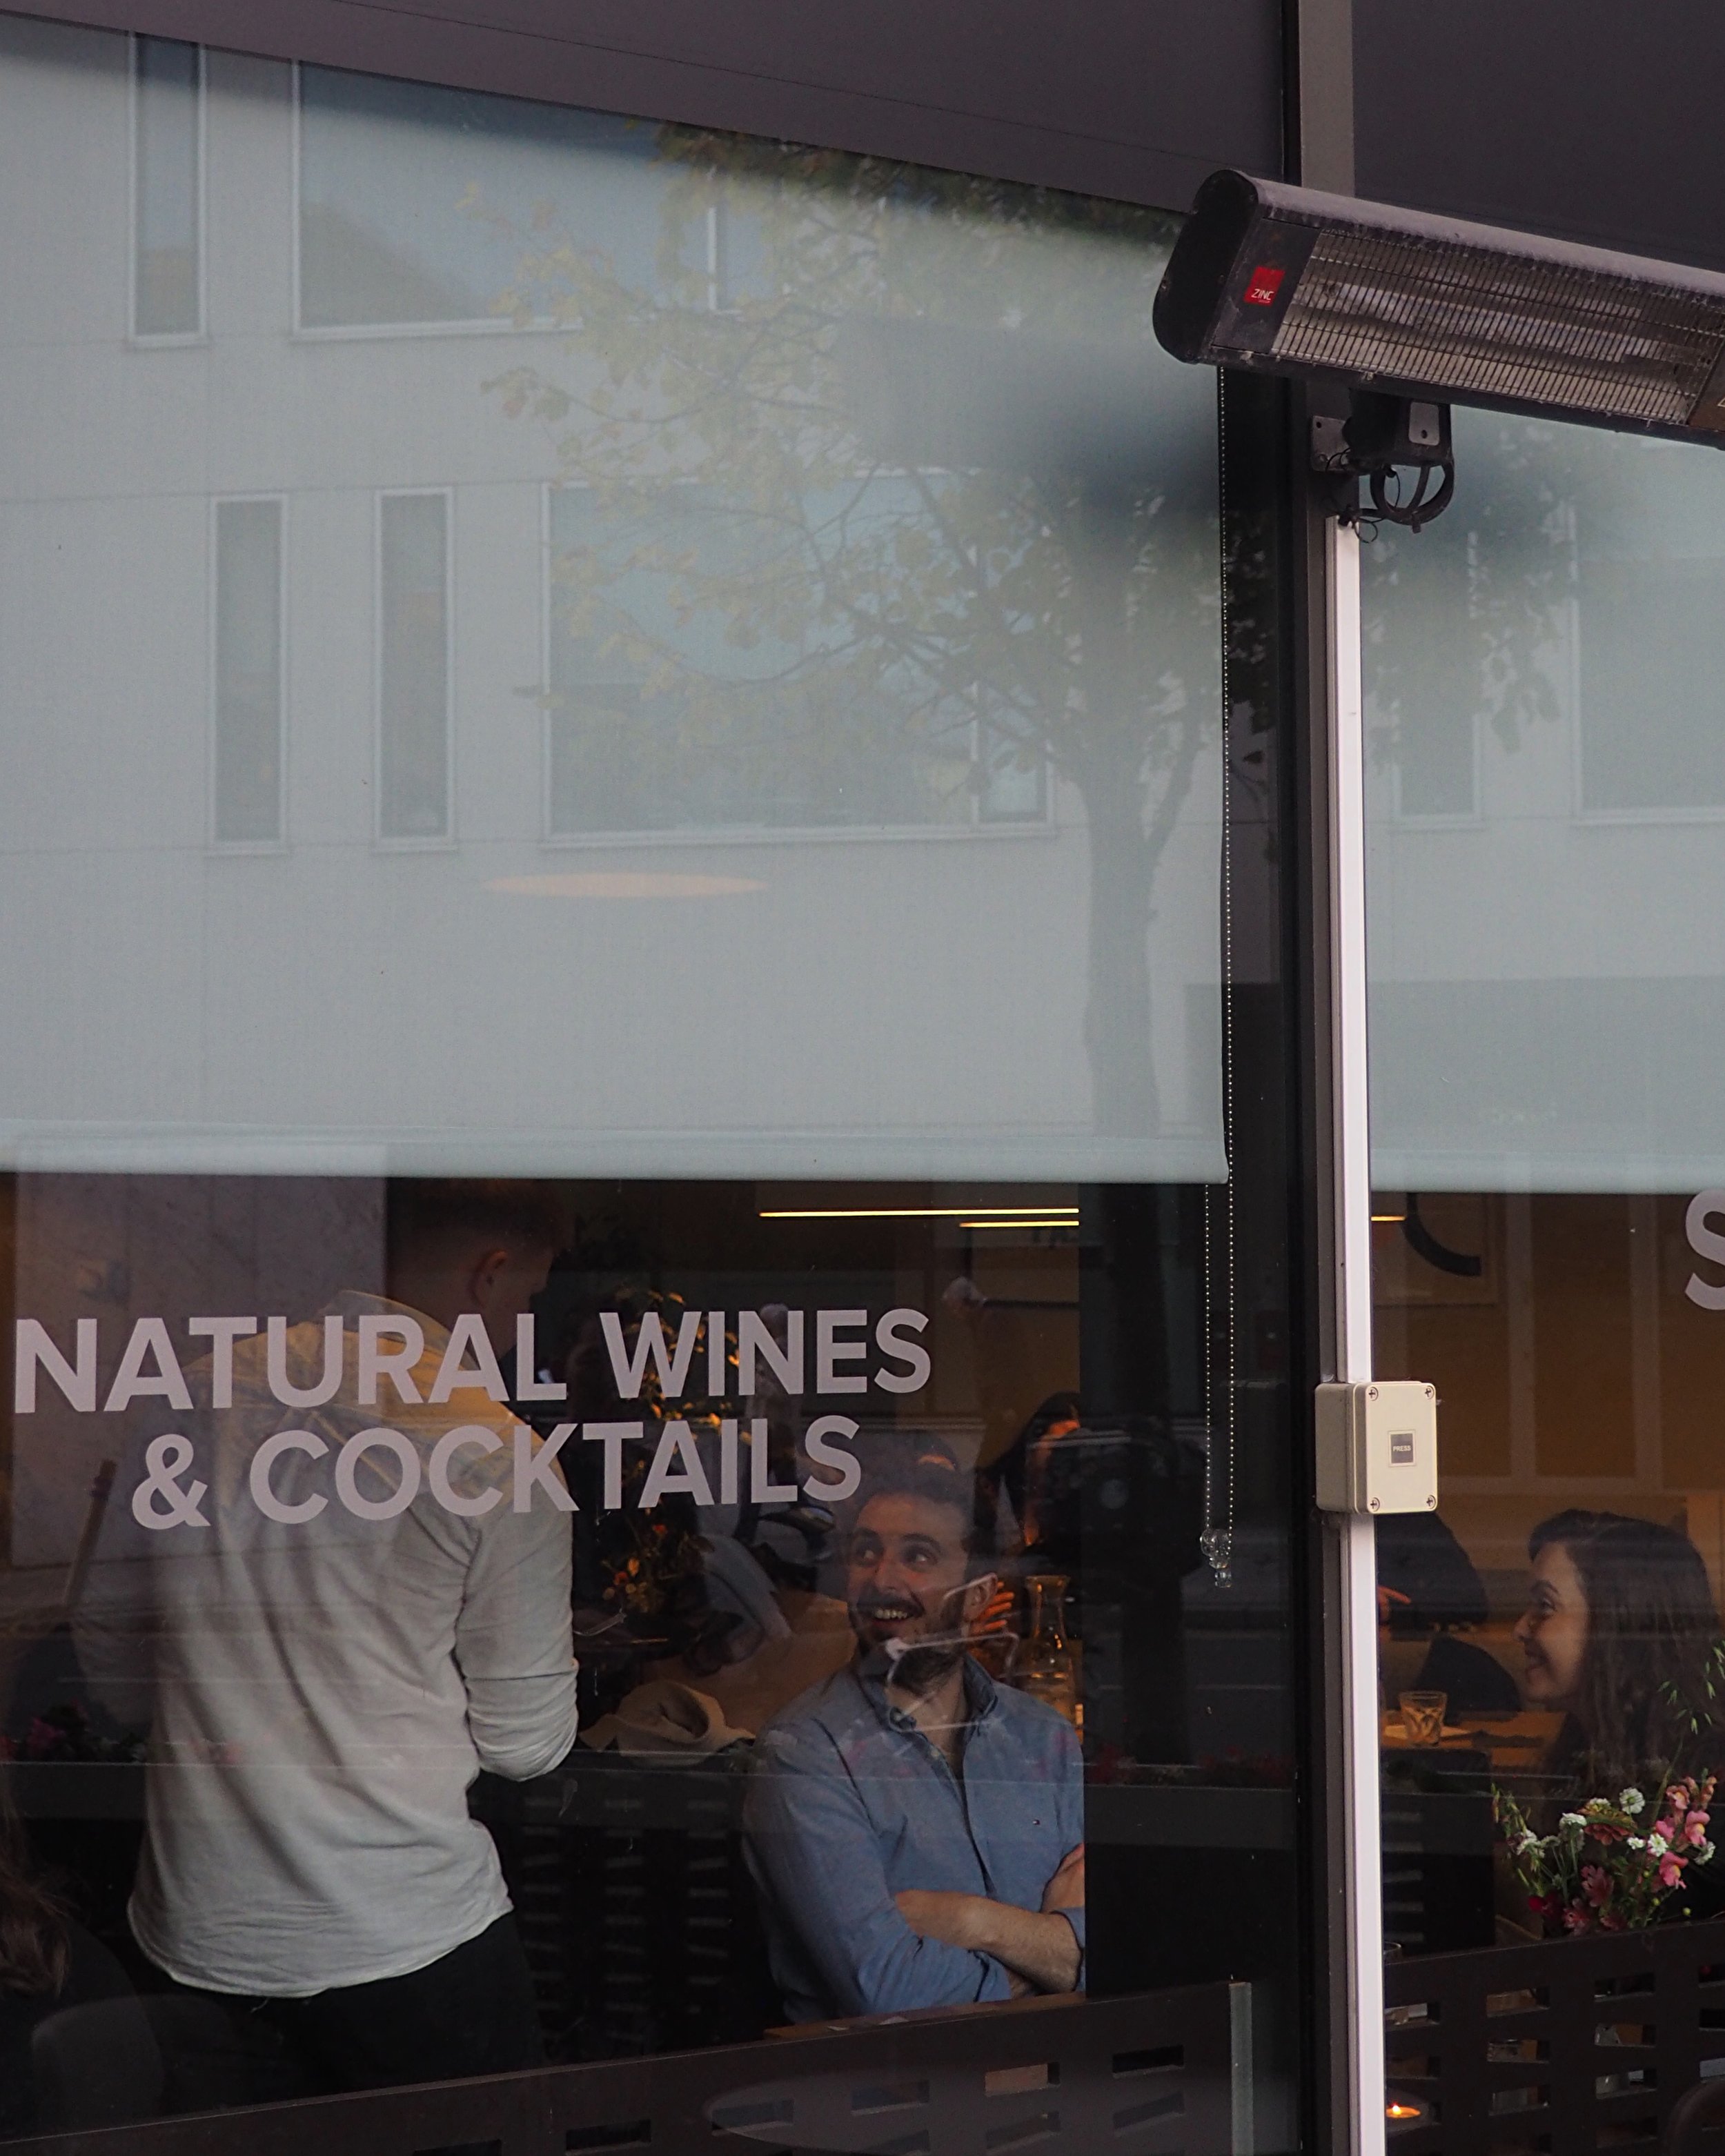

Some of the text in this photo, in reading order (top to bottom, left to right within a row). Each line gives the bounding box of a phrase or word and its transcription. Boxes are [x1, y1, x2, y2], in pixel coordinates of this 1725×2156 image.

[1251, 288, 1274, 300] ZINC
[14, 1308, 931, 1413] NATURAL WINES
[131, 1415, 862, 1530] & COCKTAILS
